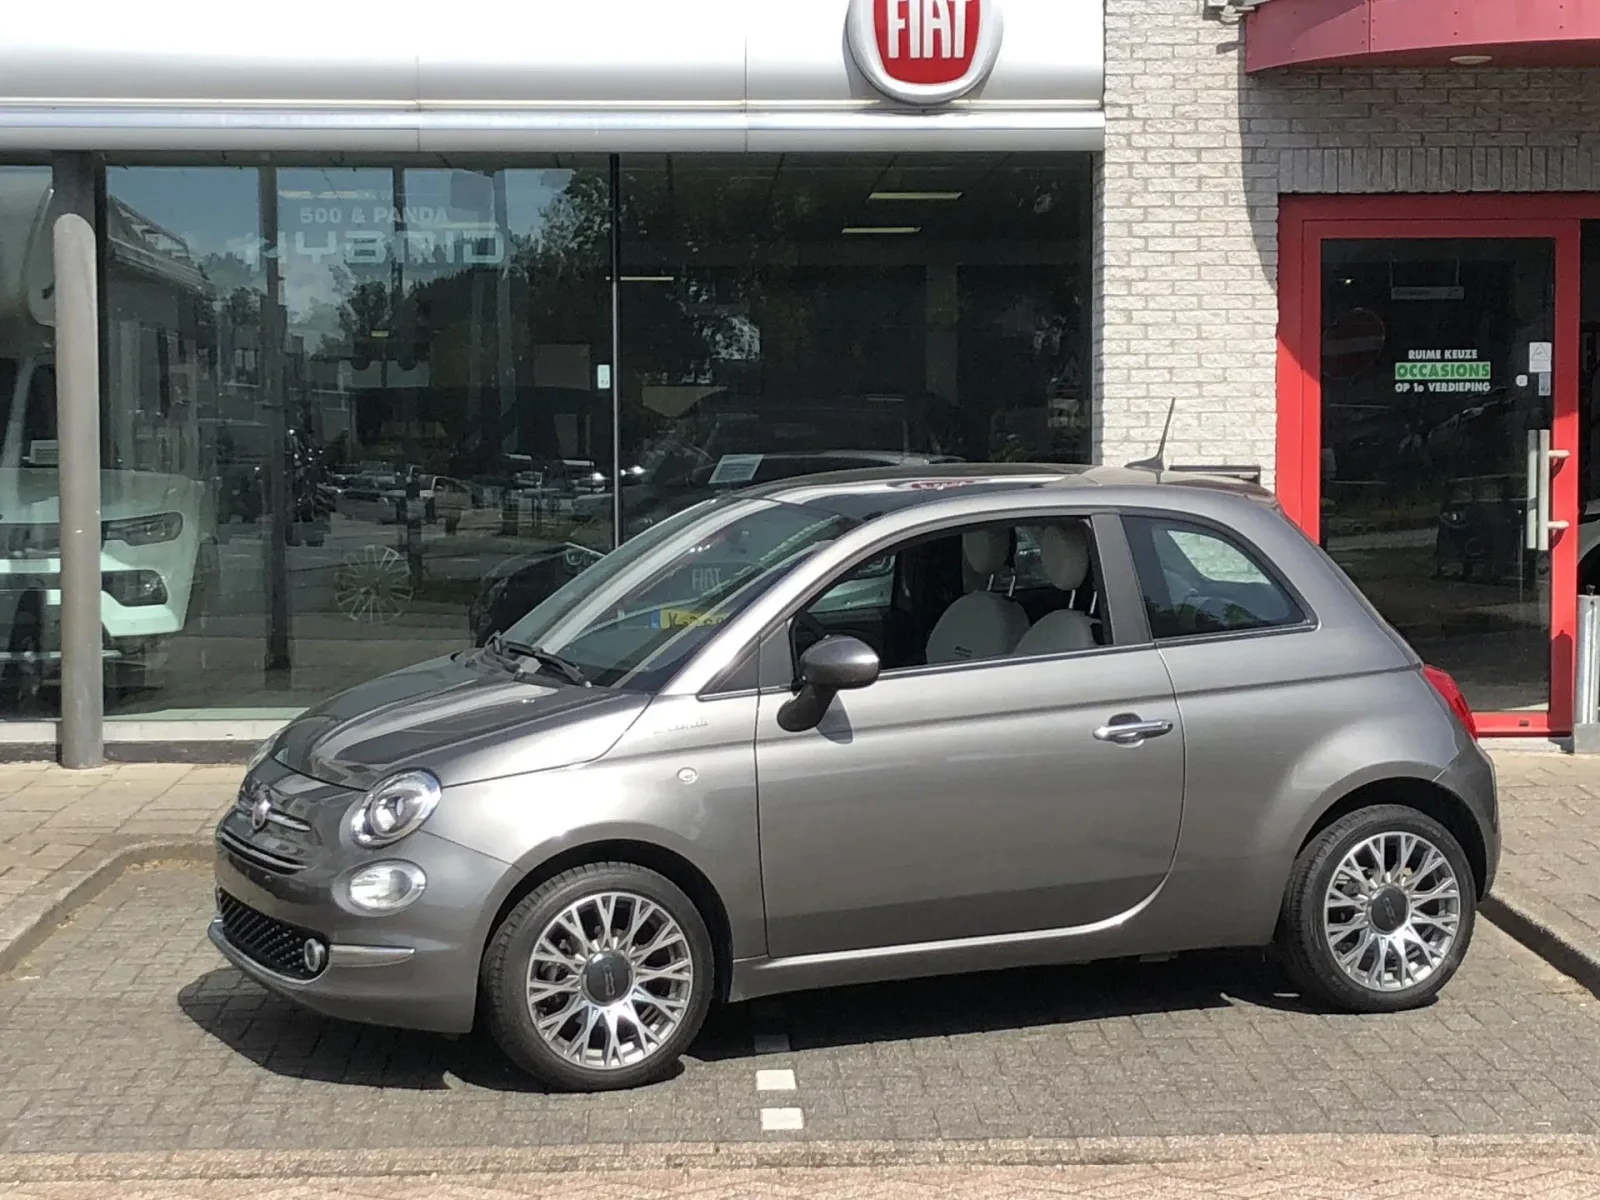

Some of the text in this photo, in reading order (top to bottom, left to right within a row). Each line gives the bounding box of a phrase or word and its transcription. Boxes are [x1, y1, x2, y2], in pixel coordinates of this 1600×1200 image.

[887, 0, 972, 58] FIAT
[301, 206, 449, 224] 500 & PANDA
[1408, 349, 1478, 360] RUIME KEUZE
[1396, 364, 1489, 378] OCCASIONS
[1395, 383, 1410, 392] OP
[1428, 382, 1491, 392] VERDIEPING
